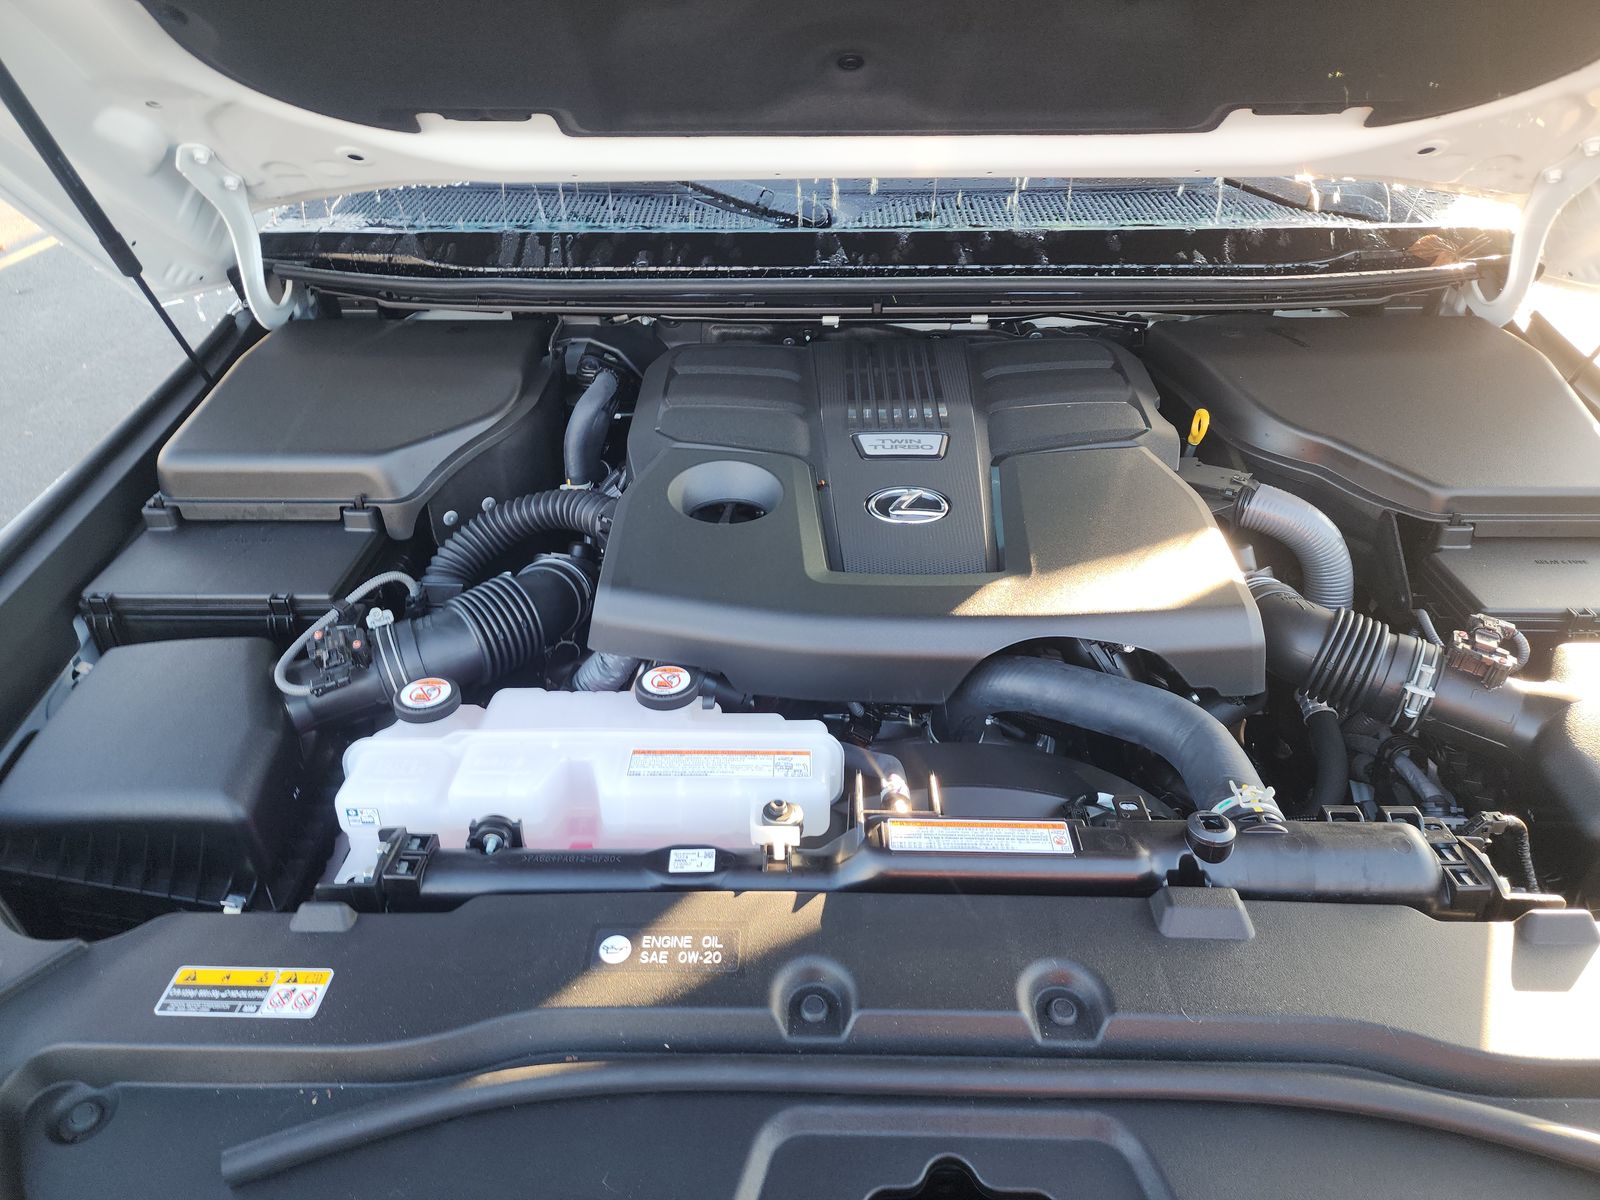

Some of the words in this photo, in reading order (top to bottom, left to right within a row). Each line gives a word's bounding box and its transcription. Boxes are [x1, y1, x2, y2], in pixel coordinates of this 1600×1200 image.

[641, 935, 693, 949] ENGINE
[701, 935, 724, 949] OIL
[640, 950, 669, 964] SAE
[678, 950, 722, 964] 0W-20
